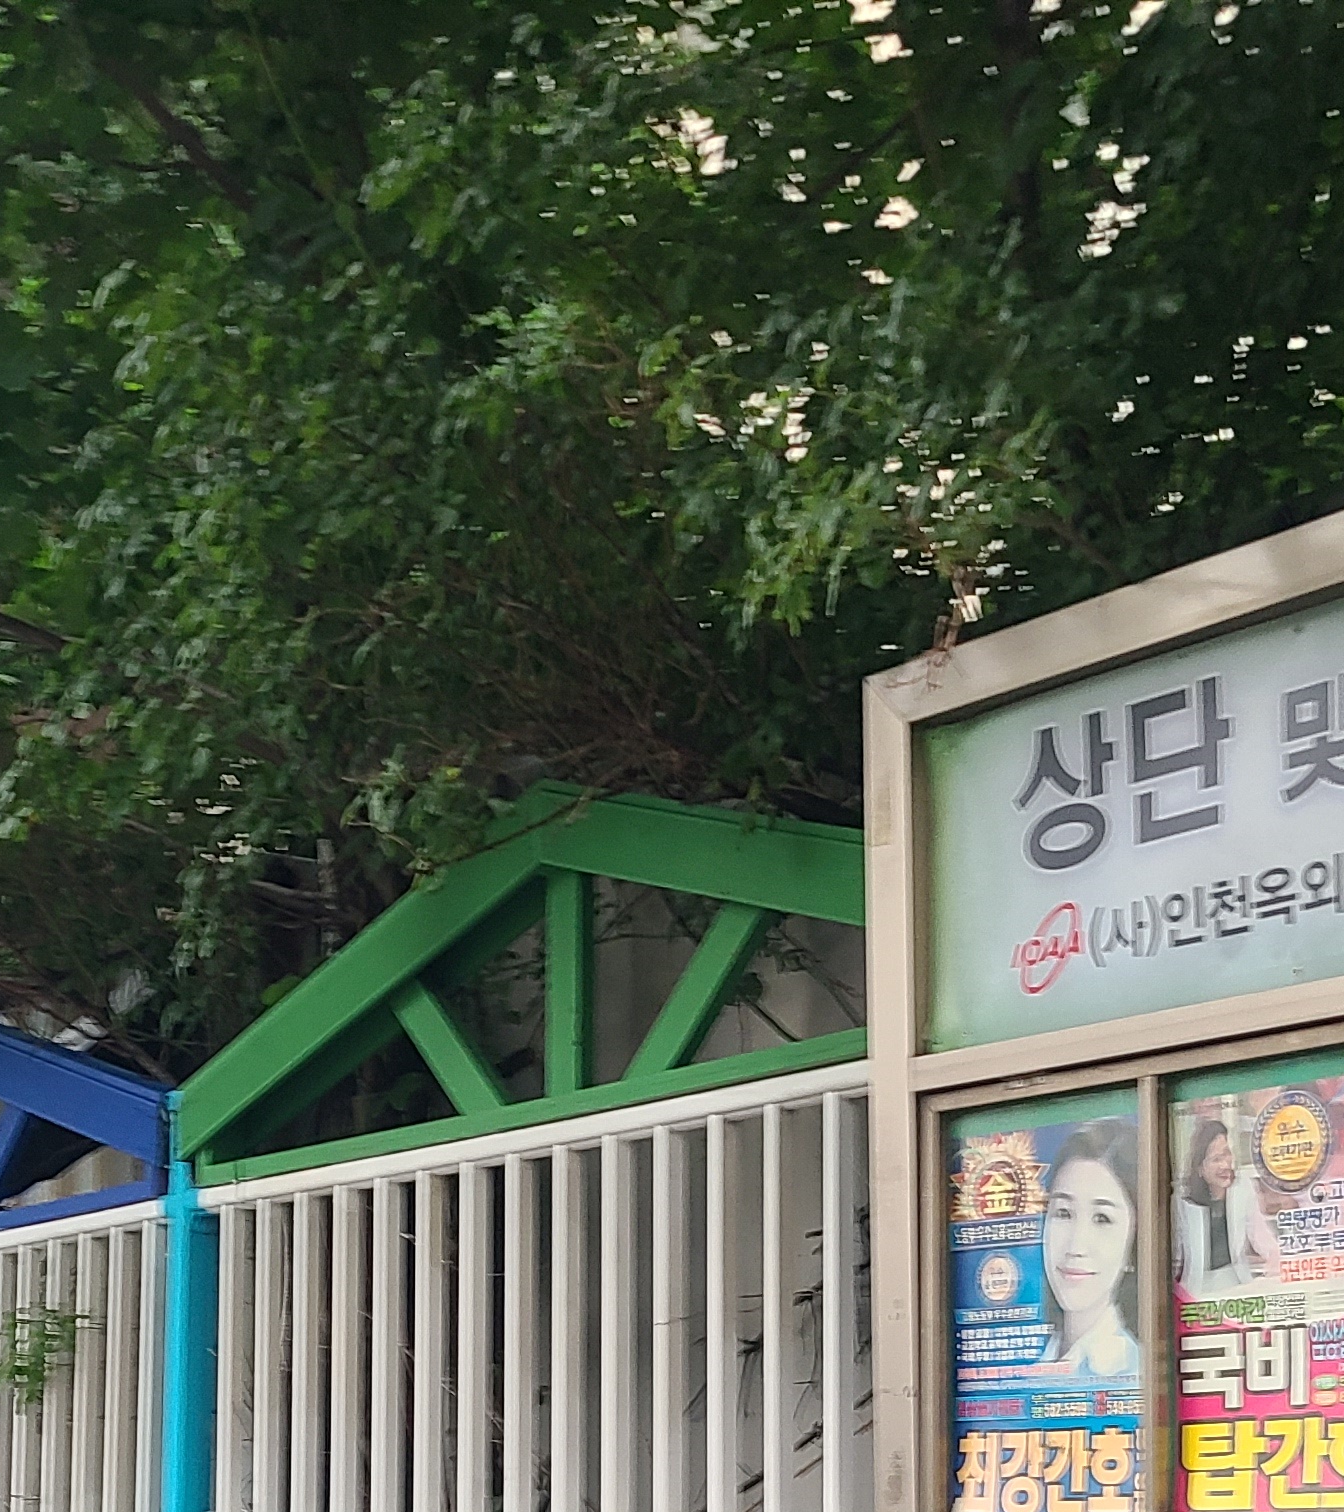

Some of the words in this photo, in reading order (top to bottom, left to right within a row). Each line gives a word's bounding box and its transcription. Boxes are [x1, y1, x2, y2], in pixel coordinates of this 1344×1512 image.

[1013, 673, 1236, 871] 상단
[1276, 1120, 1309, 1141] 우수
[1278, 1205, 1340, 1231] 역량평가
[1179, 1325, 1311, 1410] 국비
